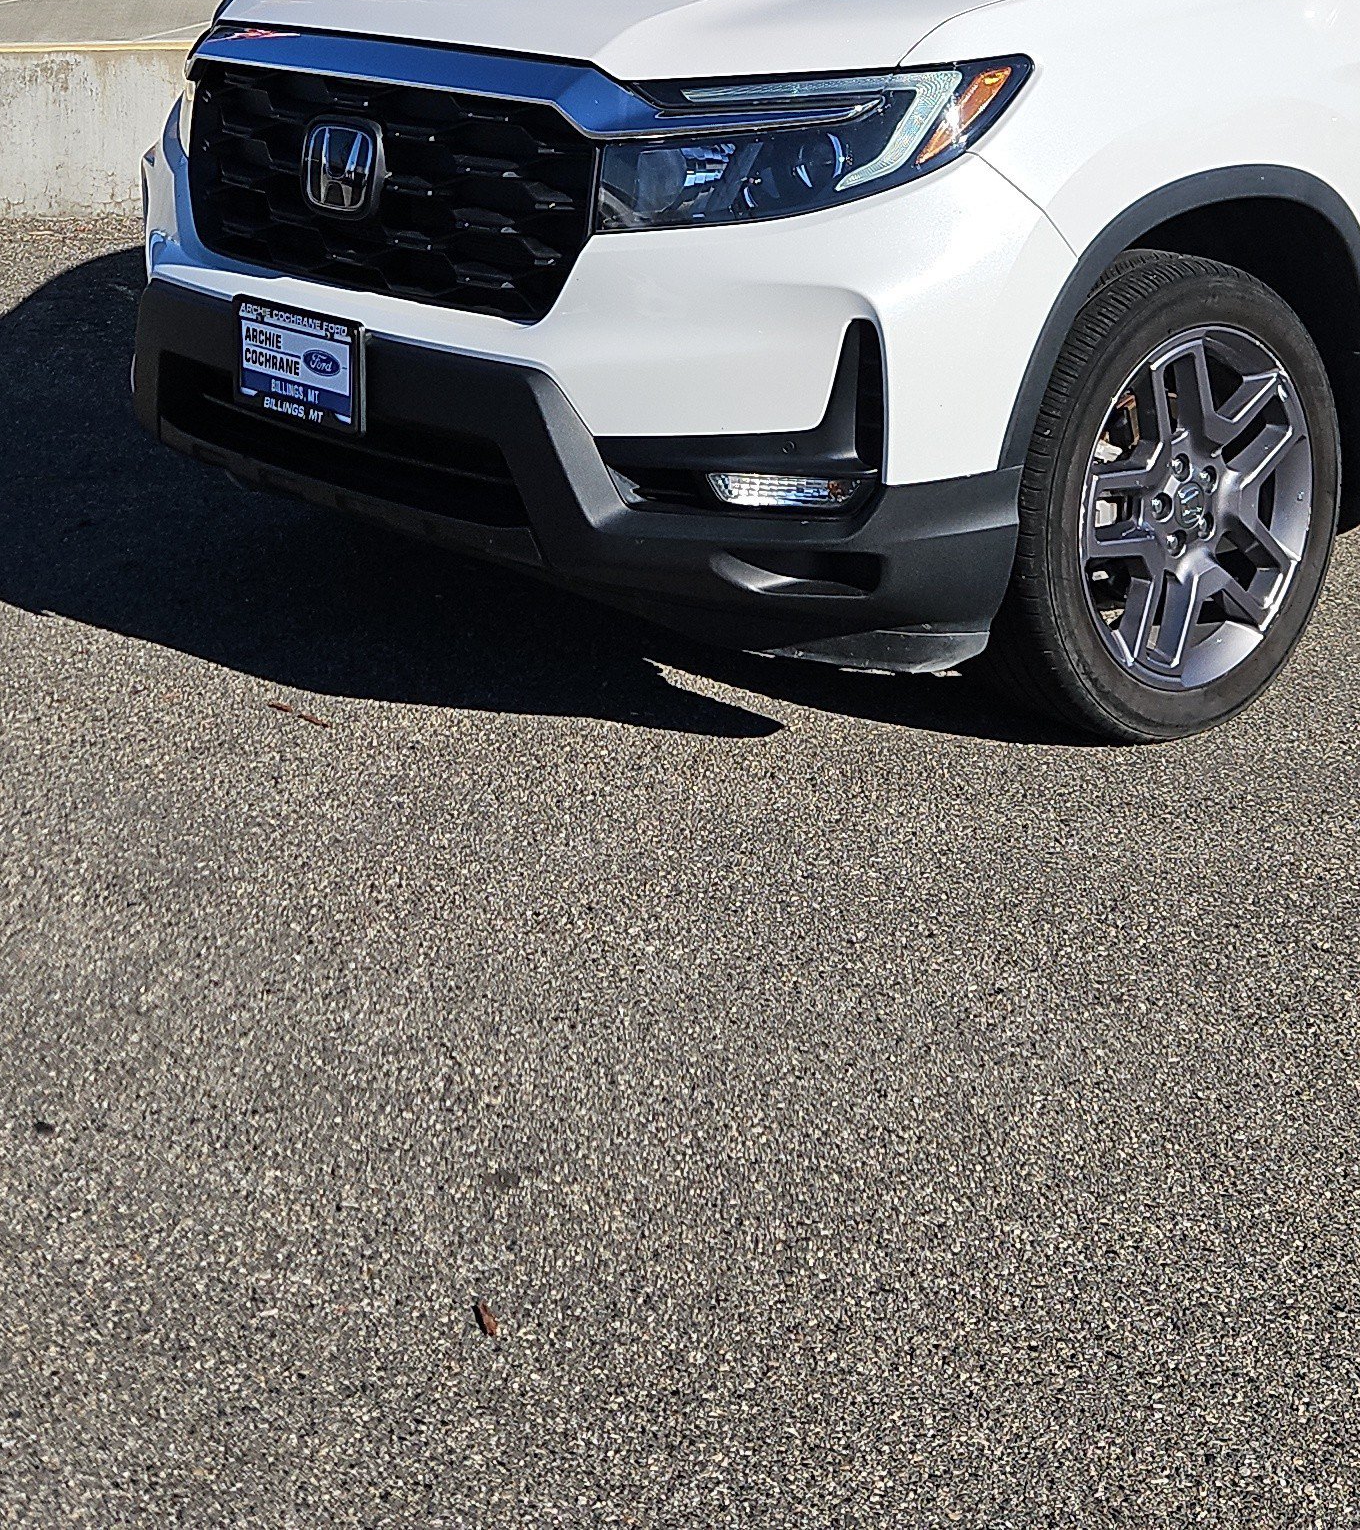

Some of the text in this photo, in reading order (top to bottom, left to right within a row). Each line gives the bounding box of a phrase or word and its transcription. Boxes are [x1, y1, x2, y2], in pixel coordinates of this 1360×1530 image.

[239, 302, 348, 336] ARCHIE COCHRANE FORD
[244, 325, 282, 350] ARCHIE
[244, 347, 300, 377] COCHRANE
[309, 353, 333, 373] Ford
[308, 388, 320, 405] MT
[263, 396, 324, 424] BILLINGS, MT
